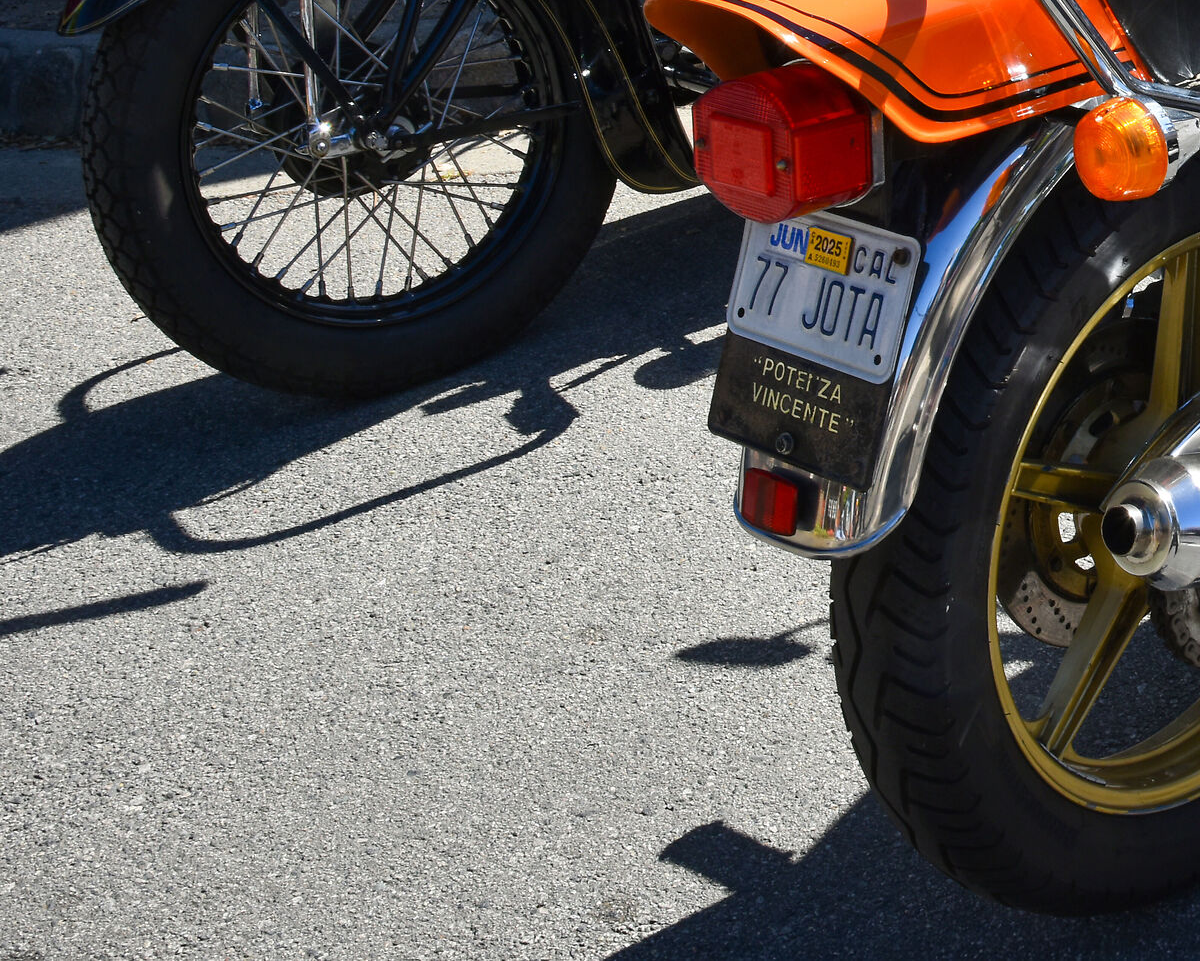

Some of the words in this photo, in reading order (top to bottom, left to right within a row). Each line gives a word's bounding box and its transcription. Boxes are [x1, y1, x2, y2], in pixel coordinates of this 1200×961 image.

[770, 223, 810, 256] JUN
[813, 234, 843, 257] 2025
[853, 245, 897, 285] CAL
[749, 255, 789, 316] 77
[801, 277, 885, 350] JOTA
